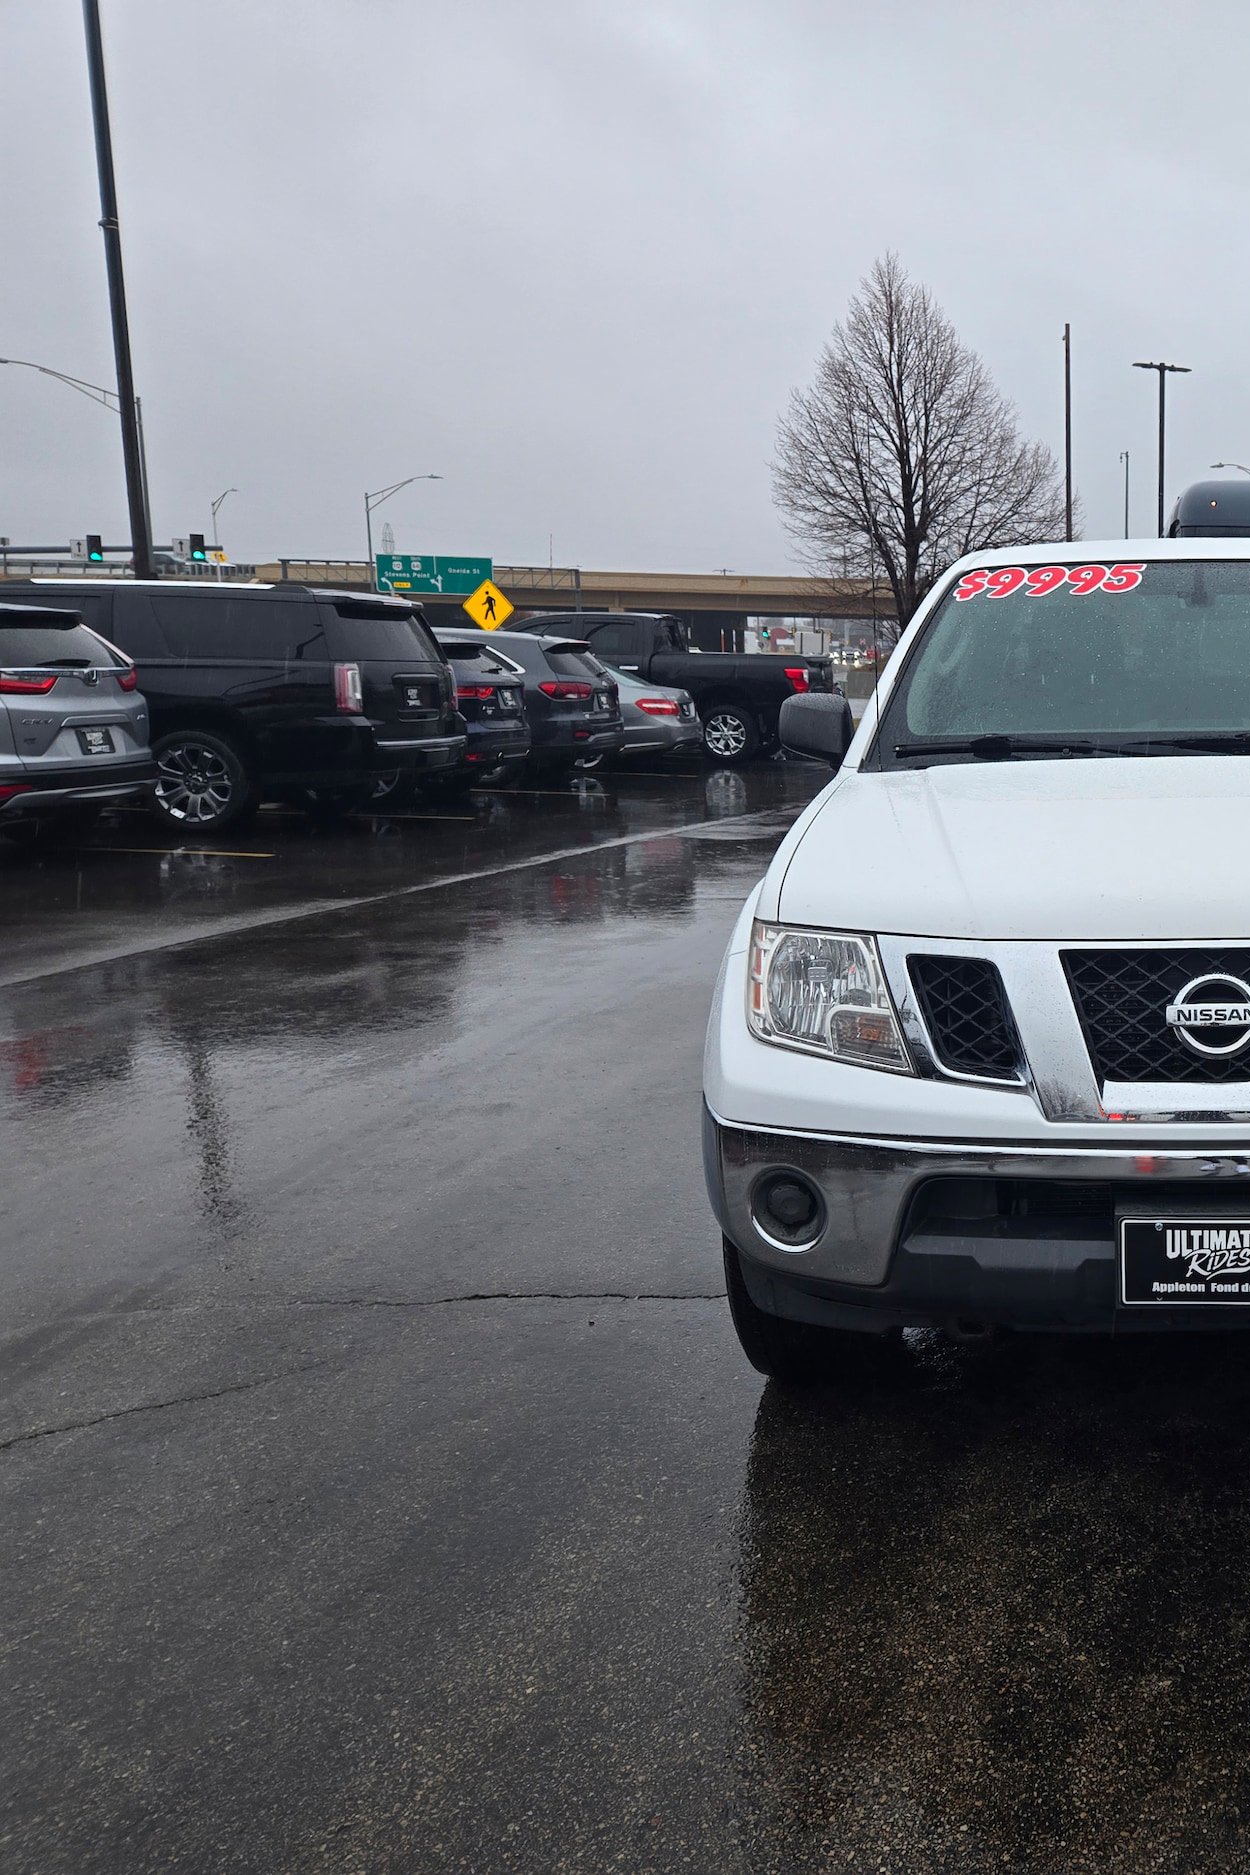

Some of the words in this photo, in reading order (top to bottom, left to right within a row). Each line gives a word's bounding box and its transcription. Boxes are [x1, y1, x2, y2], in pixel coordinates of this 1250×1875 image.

[953, 564, 1147, 601] $9995
[1152, 1282, 1205, 1293] Appleton
[1211, 1283, 1239, 1293] Fond
